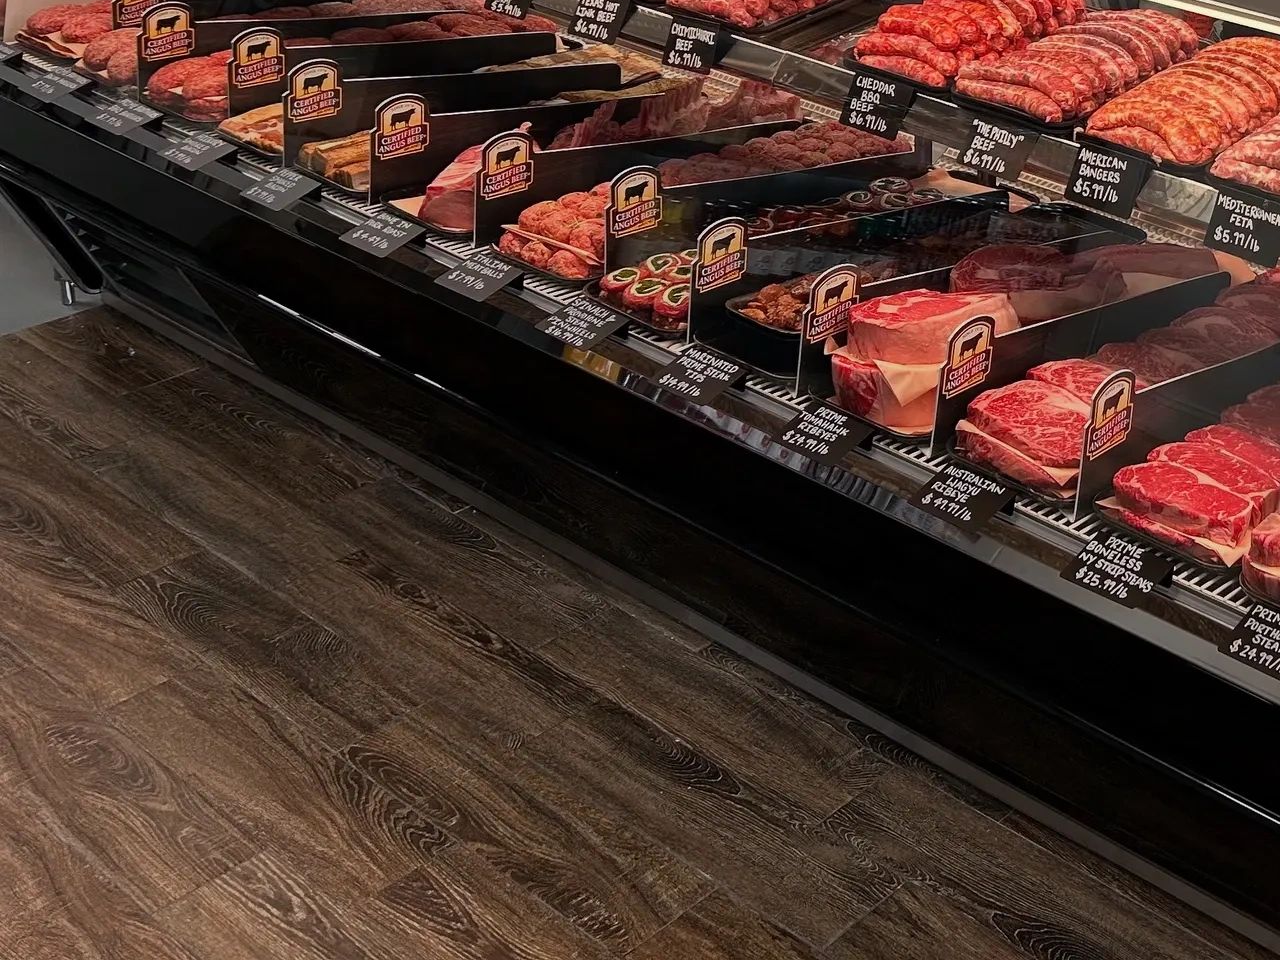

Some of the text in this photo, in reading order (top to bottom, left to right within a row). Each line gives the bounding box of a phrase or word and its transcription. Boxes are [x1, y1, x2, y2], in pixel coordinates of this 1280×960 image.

[576, 6, 617, 24] LINK BEEF
[606, 1, 621, 13] HOT
[145, 45, 172, 55] ANGUS
[148, 31, 187, 48] CERTIFIED
[675, 39, 694, 52] BEEF
[236, 66, 281, 83] ANGUS BEEF
[238, 58, 278, 75] CERTIFIED
[856, 75, 897, 97] CHEDDAR
[291, 99, 337, 117] ANGUS BEEF
[294, 91, 335, 108] CERTIFIED
[850, 99, 875, 113] BEEF
[861, 91, 881, 105] BBQ
[849, 111, 888, 133] $6.99/lb
[379, 134, 424, 153] ANGUS BEEF
[382, 126, 422, 145] CERTIFIED
[970, 135, 997, 152] BEEF
[963, 149, 1006, 173] $6.99/lb
[1079, 148, 1128, 171] AMERICAN
[484, 173, 529, 194] ANGUS BEEF
[486, 165, 527, 185] CERTIFIED
[1079, 162, 1121, 185] BANGERS
[1073, 178, 1120, 204] $5.99/lb
[614, 209, 658, 231] ANGUS BEEF
[616, 201, 656, 222] CERTIFIED
[1229, 214, 1255, 231] FETA
[1214, 225, 1261, 253] $5.99/lb
[462, 260, 505, 280] MEATBALLS
[473, 254, 512, 272] ITALIAN
[698, 261, 743, 286] ANGUS BEEF
[701, 253, 741, 276] CERTIFIED
[447, 271, 485, 290] $7.99/lb
[572, 298, 611, 319] SPINACH
[813, 301, 852, 326] CERTIFIED
[547, 316, 597, 340] PINWHEELS
[566, 316, 590, 329] STEAK
[809, 317, 837, 337] ANGUS
[678, 356, 732, 382] PRIME STEAK
[685, 348, 740, 375] MARINATED
[949, 352, 986, 381] CERTIFIED
[685, 369, 706, 384] TIPS
[946, 362, 988, 391] ANGUS BEEF
[799, 410, 850, 437] TOMAHAWK
[813, 406, 849, 426] PRIME
[1093, 409, 1128, 441] CERTIFIED
[797, 421, 839, 443] RIBEYES
[1090, 421, 1129, 452] ANGUS BEEF
[944, 465, 1007, 496] AUSTRALIAN
[946, 477, 982, 498] WAGYU
[931, 481, 971, 504] RIBEYE
[1087, 540, 1143, 572] BONELESS
[1107, 536, 1146, 559] PRIME
[1075, 566, 1129, 600] $25.99/lb
[1078, 552, 1155, 594] NY STRIP STEAKS
